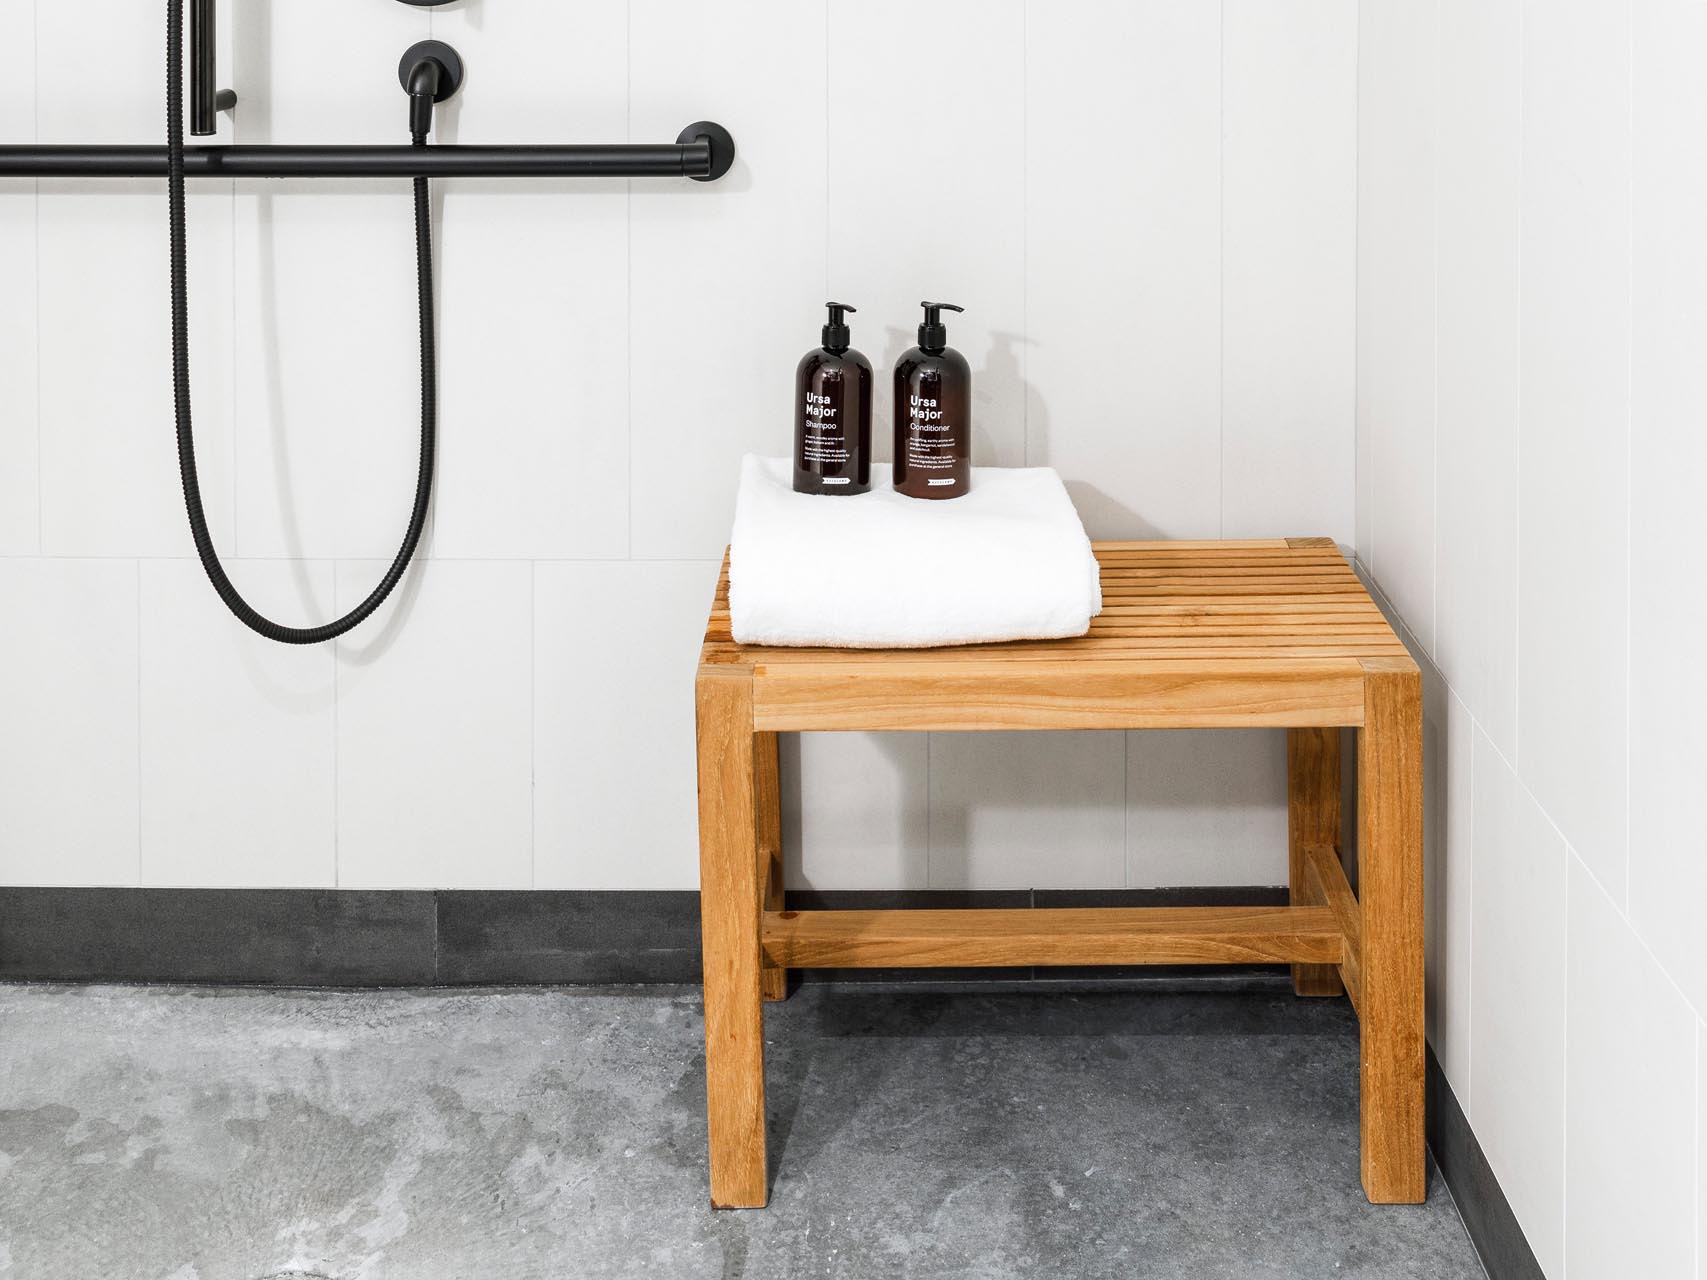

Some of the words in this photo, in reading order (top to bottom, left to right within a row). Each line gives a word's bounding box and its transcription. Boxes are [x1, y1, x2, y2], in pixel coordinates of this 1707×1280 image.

[806, 392, 831, 404] Ursa
[910, 395, 936, 407] Ursa
[806, 404, 837, 419] Major
[910, 407, 942, 421] Major
[806, 420, 836, 430] Shampoo
[910, 422, 950, 432] Conditioner
